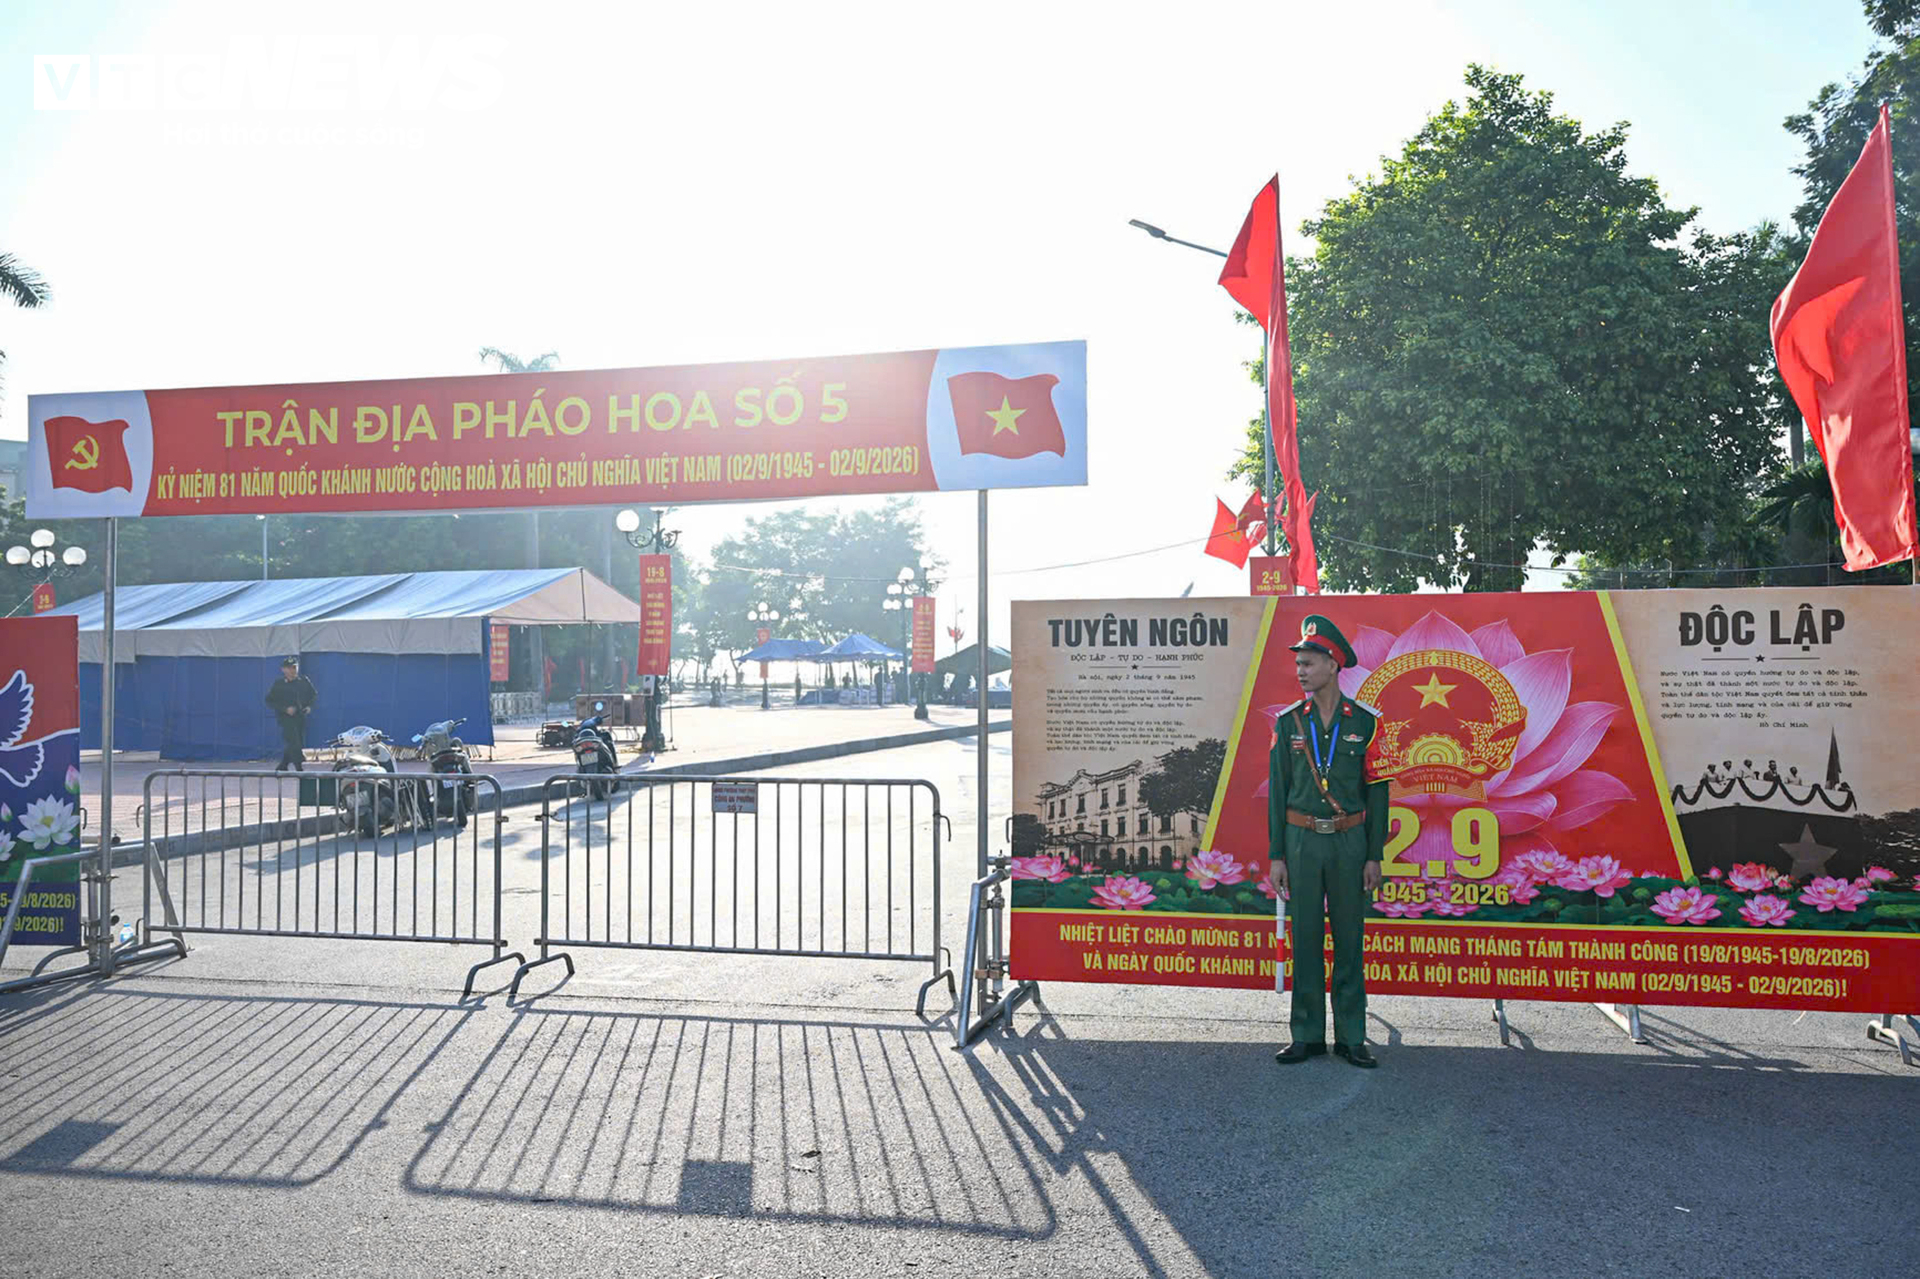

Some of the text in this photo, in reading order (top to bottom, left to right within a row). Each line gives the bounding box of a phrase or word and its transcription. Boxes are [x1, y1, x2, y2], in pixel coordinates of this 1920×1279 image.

[217, 371, 848, 456] TRẬN ĐỊA PHÁO HOA SỐ 5
[157, 466, 175, 499] KỶ
[179, 468, 215, 504] NIỆM
[220, 473, 235, 497] 81
[241, 467, 275, 497] NĂM
[279, 461, 317, 499] QUỐC
[321, 464, 371, 495] KHÁNH
[375, 462, 416, 493] NƯỚC
[421, 461, 462, 497] CỘNG
[466, 459, 497, 491] HOÀ
[501, 459, 521, 489] XÃ
[526, 457, 551, 494] HỘI
[557, 452, 588, 488] CHỦ
[593, 454, 641, 487] NGHĨA
[646, 452, 679, 490] VIỆT
[683, 455, 721, 483] NAM
[727, 452, 814, 484] (02/9/1945
[830, 446, 919, 477] 02/9/2026)
[1262, 571, 1281, 584] 2-9
[1048, 613, 1228, 647] TUYÊN NGÔN
[1679, 603, 1845, 652] ĐỘC LẬP
[1070, 654, 1087, 662] ĐỘC
[1090, 654, 1106, 662] LẬP
[1181, 653, 1204, 661] PHÚC
[1381, 807, 1500, 879] 2.9
[1372, 882, 1426, 903] 1945
[1450, 884, 1509, 905] 2026
[1060, 922, 1104, 945] NHIỆT
[1109, 923, 1139, 947] LIỆT
[1144, 925, 1186, 944] CHÀO
[1191, 926, 1239, 947] MỪNG
[1244, 931, 1261, 948] 81
[1363, 932, 1405, 953] CÁCH
[1410, 936, 1460, 958] MẠNG
[1465, 935, 1522, 957] THÁNG
[1527, 937, 1563, 958] TÁM
[1569, 938, 1625, 960] THÀNH
[1631, 940, 1678, 962] CÔNG
[1684, 944, 1870, 970] (19/8/1945-19/8/2026)
[1083, 950, 1102, 970] VÀ
[1107, 951, 1149, 971] NGÀY
[1153, 951, 1196, 974] QUỐC
[1201, 954, 1255, 976] KHÁNH
[1397, 962, 1419, 982] XÃ
[1425, 963, 1451, 986] HỘI
[1457, 962, 1491, 985] CHỦ
[1496, 966, 1549, 986] NGHĨA
[1554, 967, 1589, 992] VIỆT
[1595, 972, 1635, 990] NAM
[1642, 973, 1731, 993] (02/9/1945
[1749, 975, 1847, 998] 02/9/2026)!
